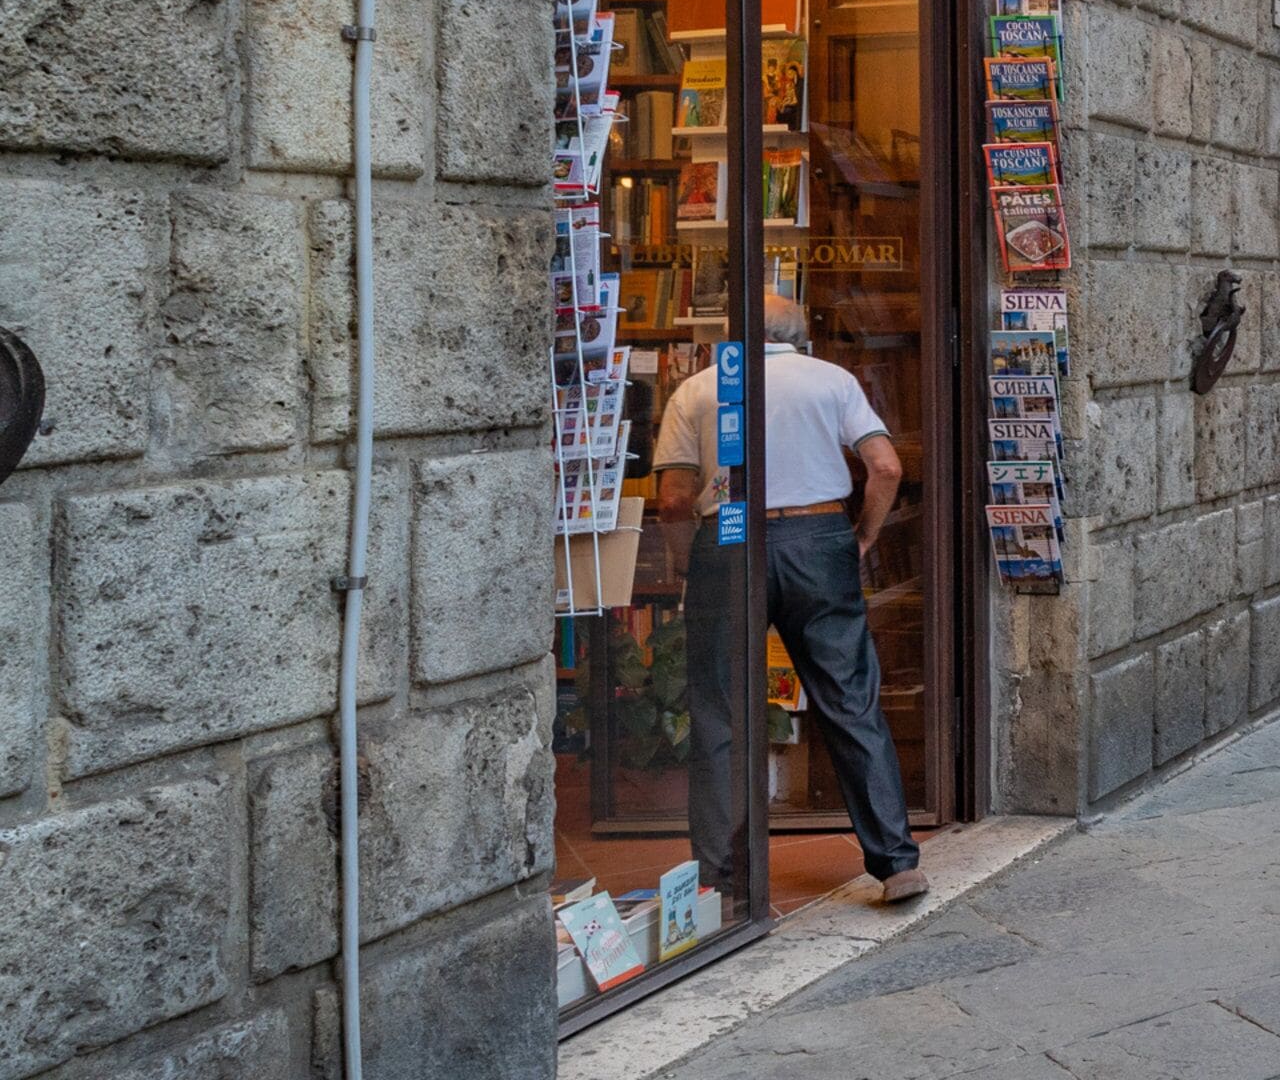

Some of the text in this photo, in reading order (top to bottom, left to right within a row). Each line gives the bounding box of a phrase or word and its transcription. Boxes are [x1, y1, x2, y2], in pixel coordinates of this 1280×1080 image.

[1006, 21, 1040, 31] COCINA
[999, 30, 1050, 41] TOSCANA
[1001, 74, 1039, 84] KEUKEN
[992, 106, 1050, 118] TOSKANISCHE
[1007, 118, 1039, 128] KÜCHE
[1003, 148, 1042, 158] CUISINE
[1001, 192, 1051, 206] PÂTES
[767, 244, 898, 264] PALOMAR
[1005, 295, 1063, 310] SIENA
[994, 381, 1050, 395] СИЕНА
[994, 424, 1051, 439] SIENA
[993, 466, 1048, 481] シエナ
[992, 510, 1048, 525] SIENA
